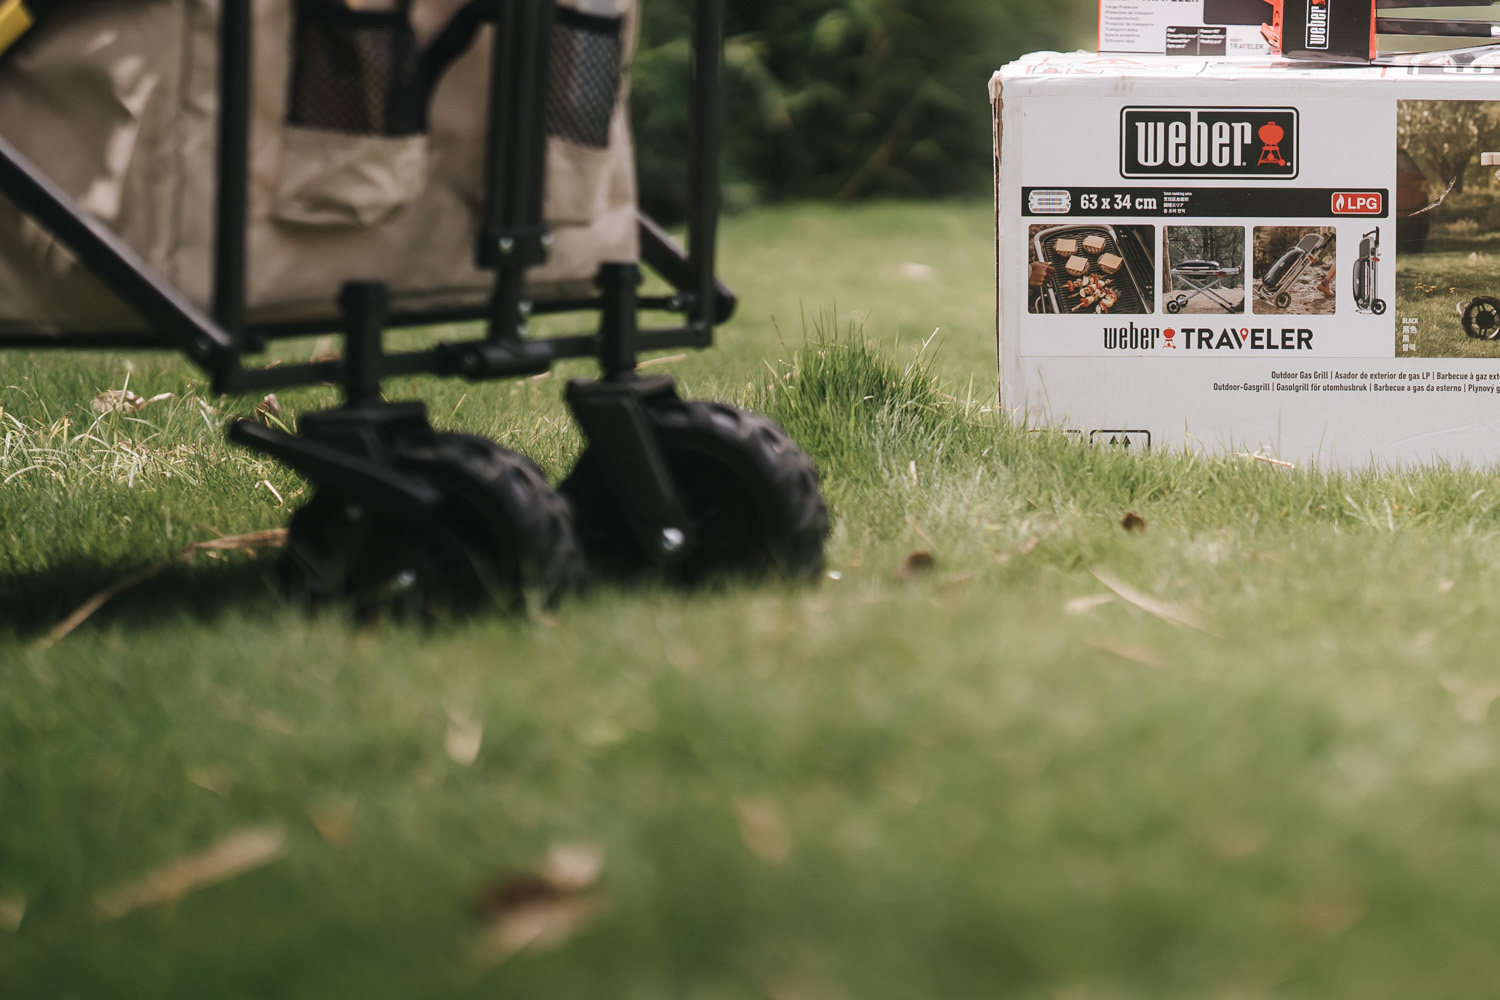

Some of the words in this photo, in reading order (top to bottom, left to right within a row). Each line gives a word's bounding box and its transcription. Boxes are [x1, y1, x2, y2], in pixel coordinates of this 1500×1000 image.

[1308, 6, 1327, 45] weber
[1135, 111, 1252, 167] weber
[1080, 194, 1098, 210] 63
[1101, 199, 1110, 210] x
[1114, 194, 1131, 210] 34
[1135, 198, 1157, 210] cm
[1347, 197, 1378, 211] LPG
[1103, 321, 1159, 350] weber
[1181, 328, 1314, 350] TRAVELER
[1271, 371, 1298, 379] Outdoor
[1300, 371, 1312, 379] Gas
[1313, 371, 1329, 379] Grill
[1335, 371, 1358, 379] Asador
[1360, 371, 1368, 379] de
[1370, 371, 1397, 379] exterior
[1398, 371, 1407, 380] de
[1408, 373, 1420, 381] gas
[1422, 372, 1430, 380] LP
[1436, 372, 1468, 380] Barbecue
[1469, 371, 1474, 380] à
[1213, 382, 1270, 392] Outdoor-Gasgrill
[1276, 382, 1309, 392] Gasolgrill
[1310, 382, 1321, 391] för
[1322, 382, 1367, 391] utomhusbruk
[1374, 383, 1405, 391] Barbecue
[1468, 383, 1495, 393] Plynový
